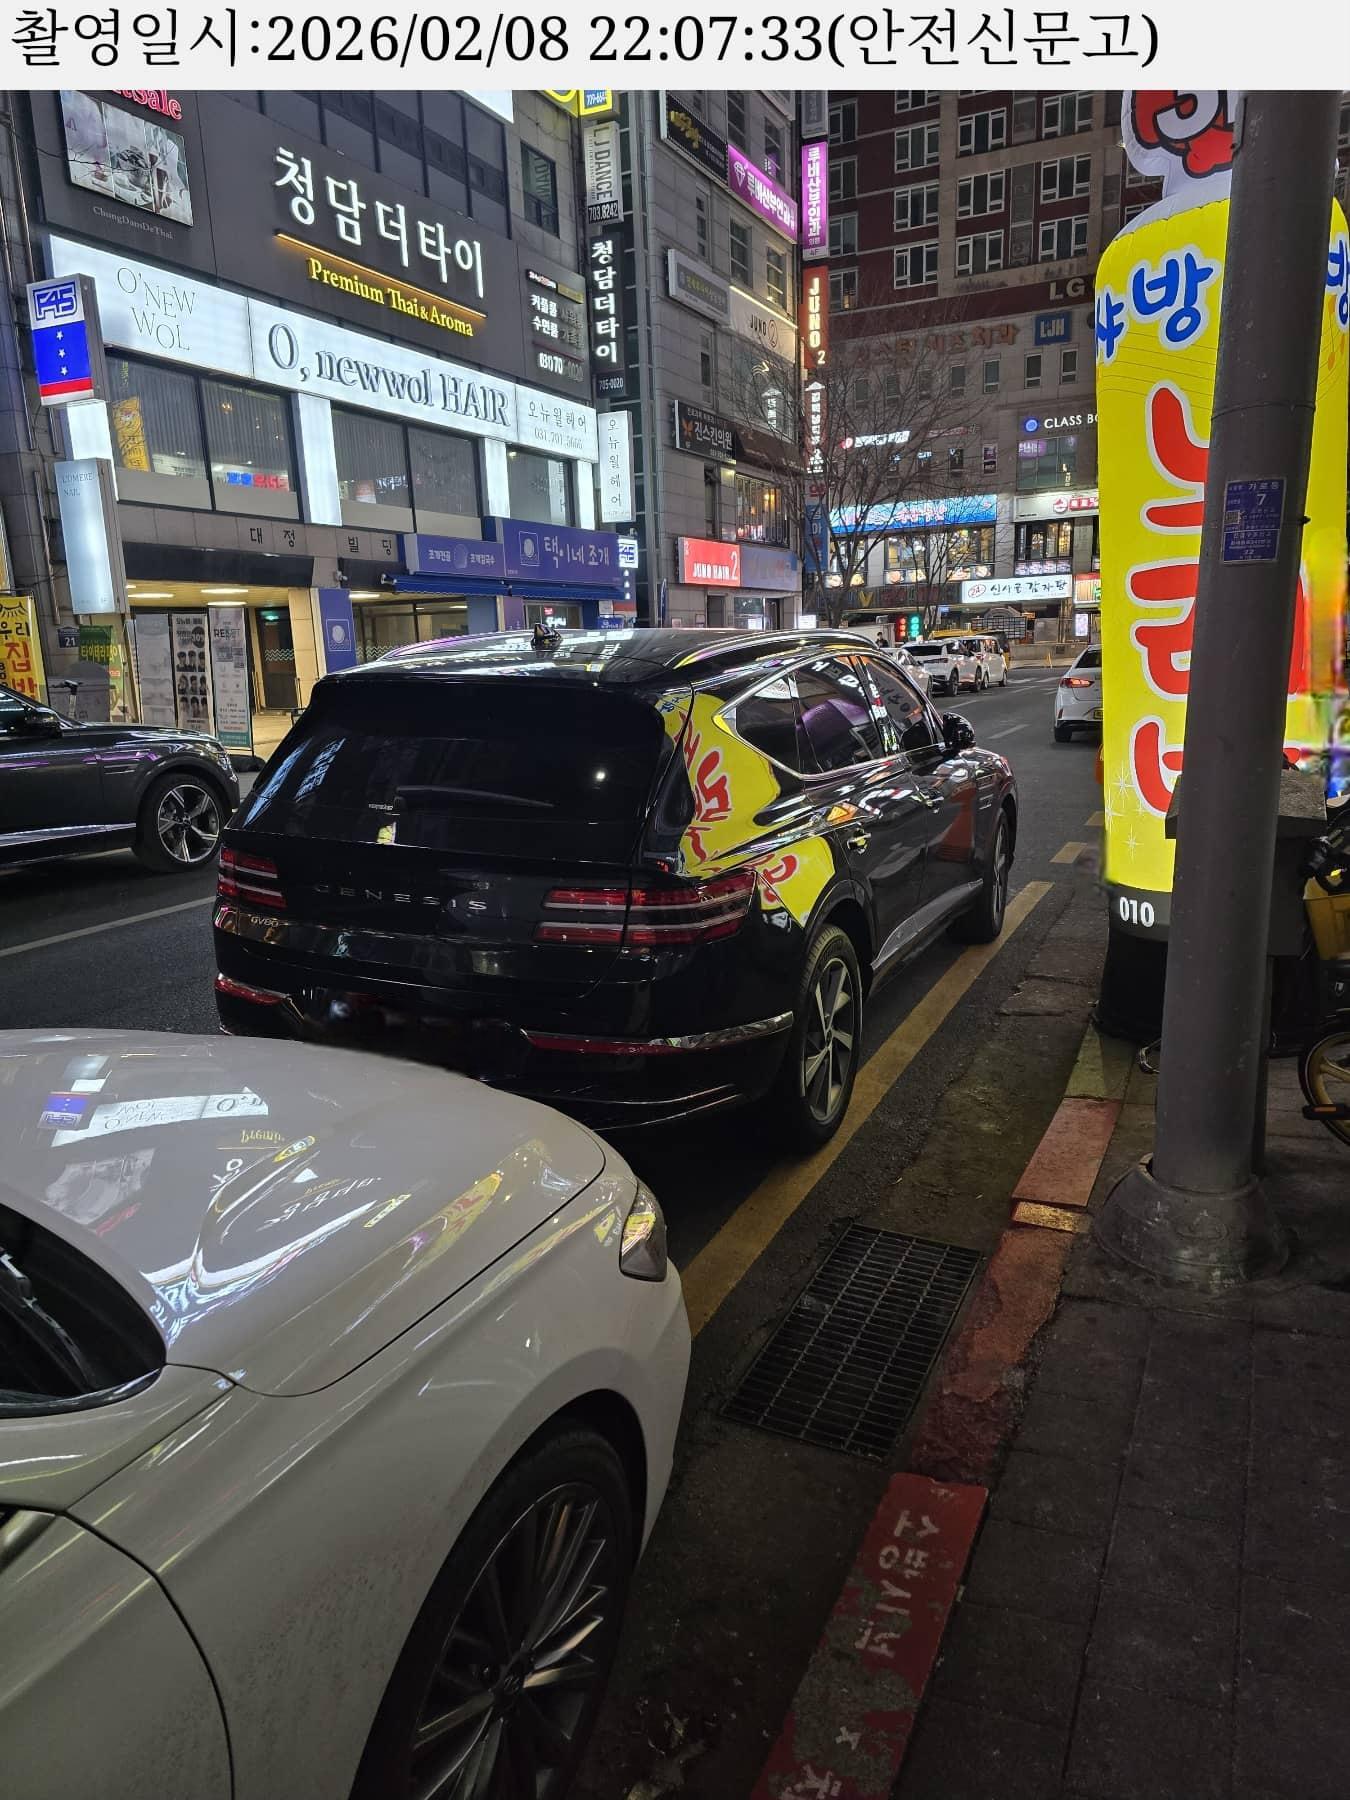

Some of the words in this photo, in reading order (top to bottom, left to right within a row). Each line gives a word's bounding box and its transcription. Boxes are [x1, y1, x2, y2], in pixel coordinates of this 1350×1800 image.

[594, 148, 613, 201] DANCE
[274, 146, 485, 300] 청담더타이
[588, 201, 618, 221] 703.8242
[307, 257, 385, 305] Premium
[1050, 277, 1086, 300] LG
[32, 281, 78, 321] F45
[590, 239, 621, 364] 청담더타이
[808, 277, 822, 349] JUNO
[131, 306, 192, 351] WOL
[749, 313, 767, 337] JUNO
[816, 349, 826, 365] 2
[316, 349, 434, 408] newwol
[439, 372, 512, 428] HAIR
[527, 400, 588, 434] 오뉴월헤어
[1044, 414, 1082, 429] CLASS
[694, 421, 733, 450] 진스킨의원
[608, 419, 622, 507] 오뉴월헤어
[1248, 481, 1279, 491] 가로등
[1256, 493, 1267, 506] 7
[587, 543, 610, 567] 조개
[692, 562, 712, 578] JUNO
[713, 563, 730, 581] HAIR
[730, 550, 739, 582] 2
[0, 621, 31, 641] 우리
[64, 637, 76, 647] 21
[313, 882, 488, 911] GENESIS
[250, 915, 280, 928] GV80
[1118, 896, 1156, 928] 010
